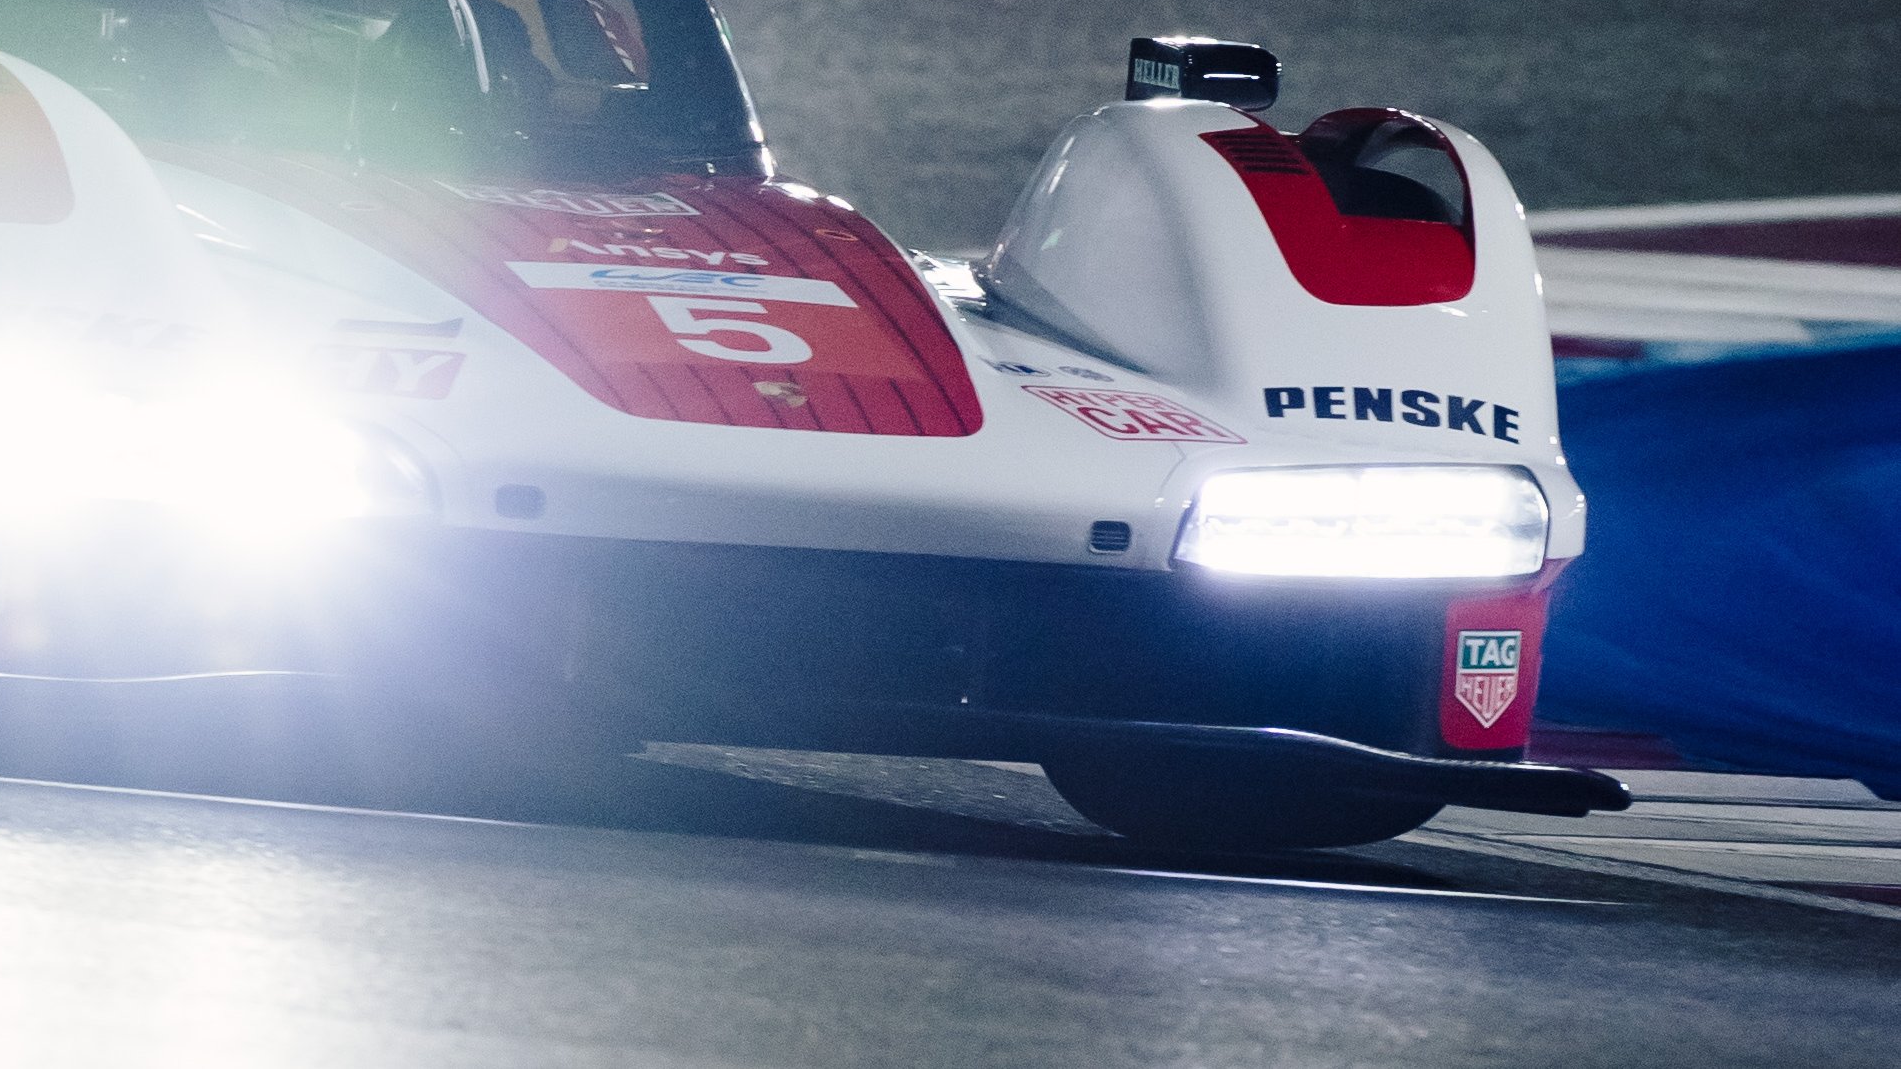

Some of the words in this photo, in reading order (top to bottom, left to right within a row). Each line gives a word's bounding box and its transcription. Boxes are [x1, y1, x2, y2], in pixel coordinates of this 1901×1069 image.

[1133, 58, 1180, 90] HELLER
[546, 236, 769, 267] Ansys
[645, 295, 814, 364] 5
[1039, 389, 1186, 411] HYPER
[1263, 386, 1520, 444] PENSKE
[1077, 406, 1232, 438] CAR
[1465, 638, 1517, 667] TAG
[1460, 676, 1516, 720] HEUER
